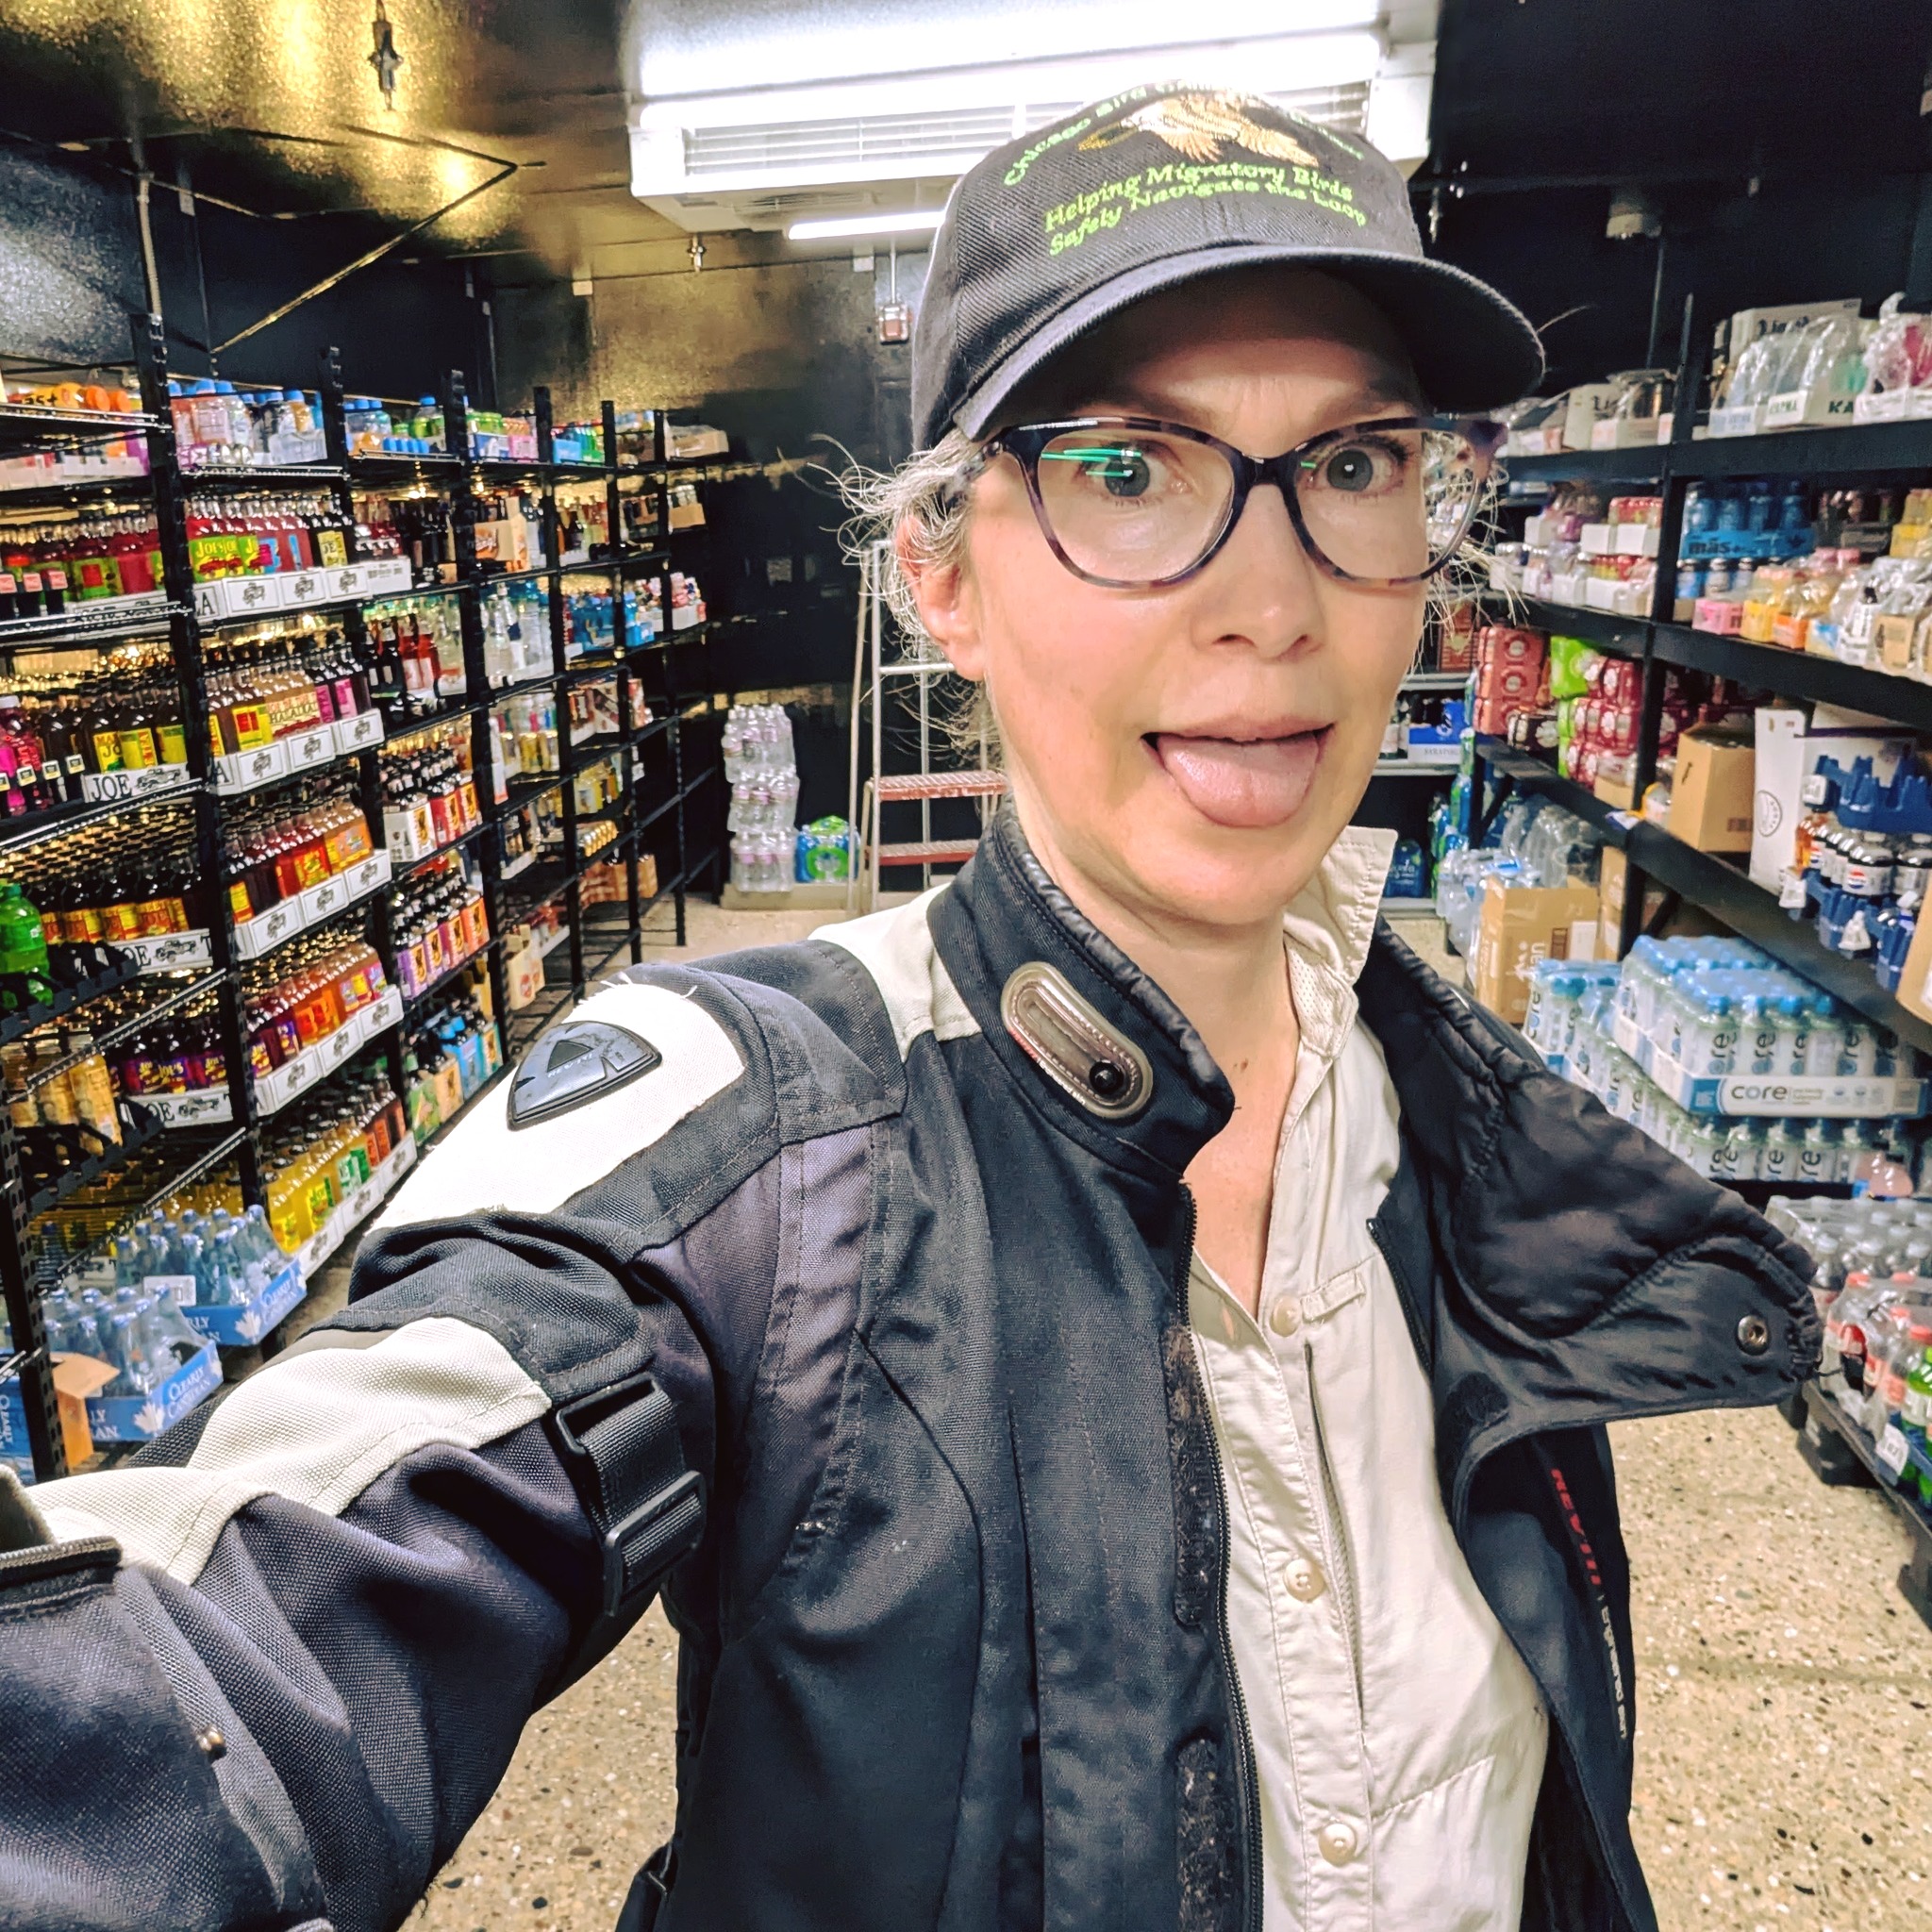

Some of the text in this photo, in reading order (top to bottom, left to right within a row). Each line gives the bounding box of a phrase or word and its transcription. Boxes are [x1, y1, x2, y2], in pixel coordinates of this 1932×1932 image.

[1045, 161, 1353, 233] Helping Migratory Birds
[1050, 178, 1366, 257] Safely Navigate the Loop
[92, 774, 132, 801] JOE
[1730, 1085, 1788, 1100] core
